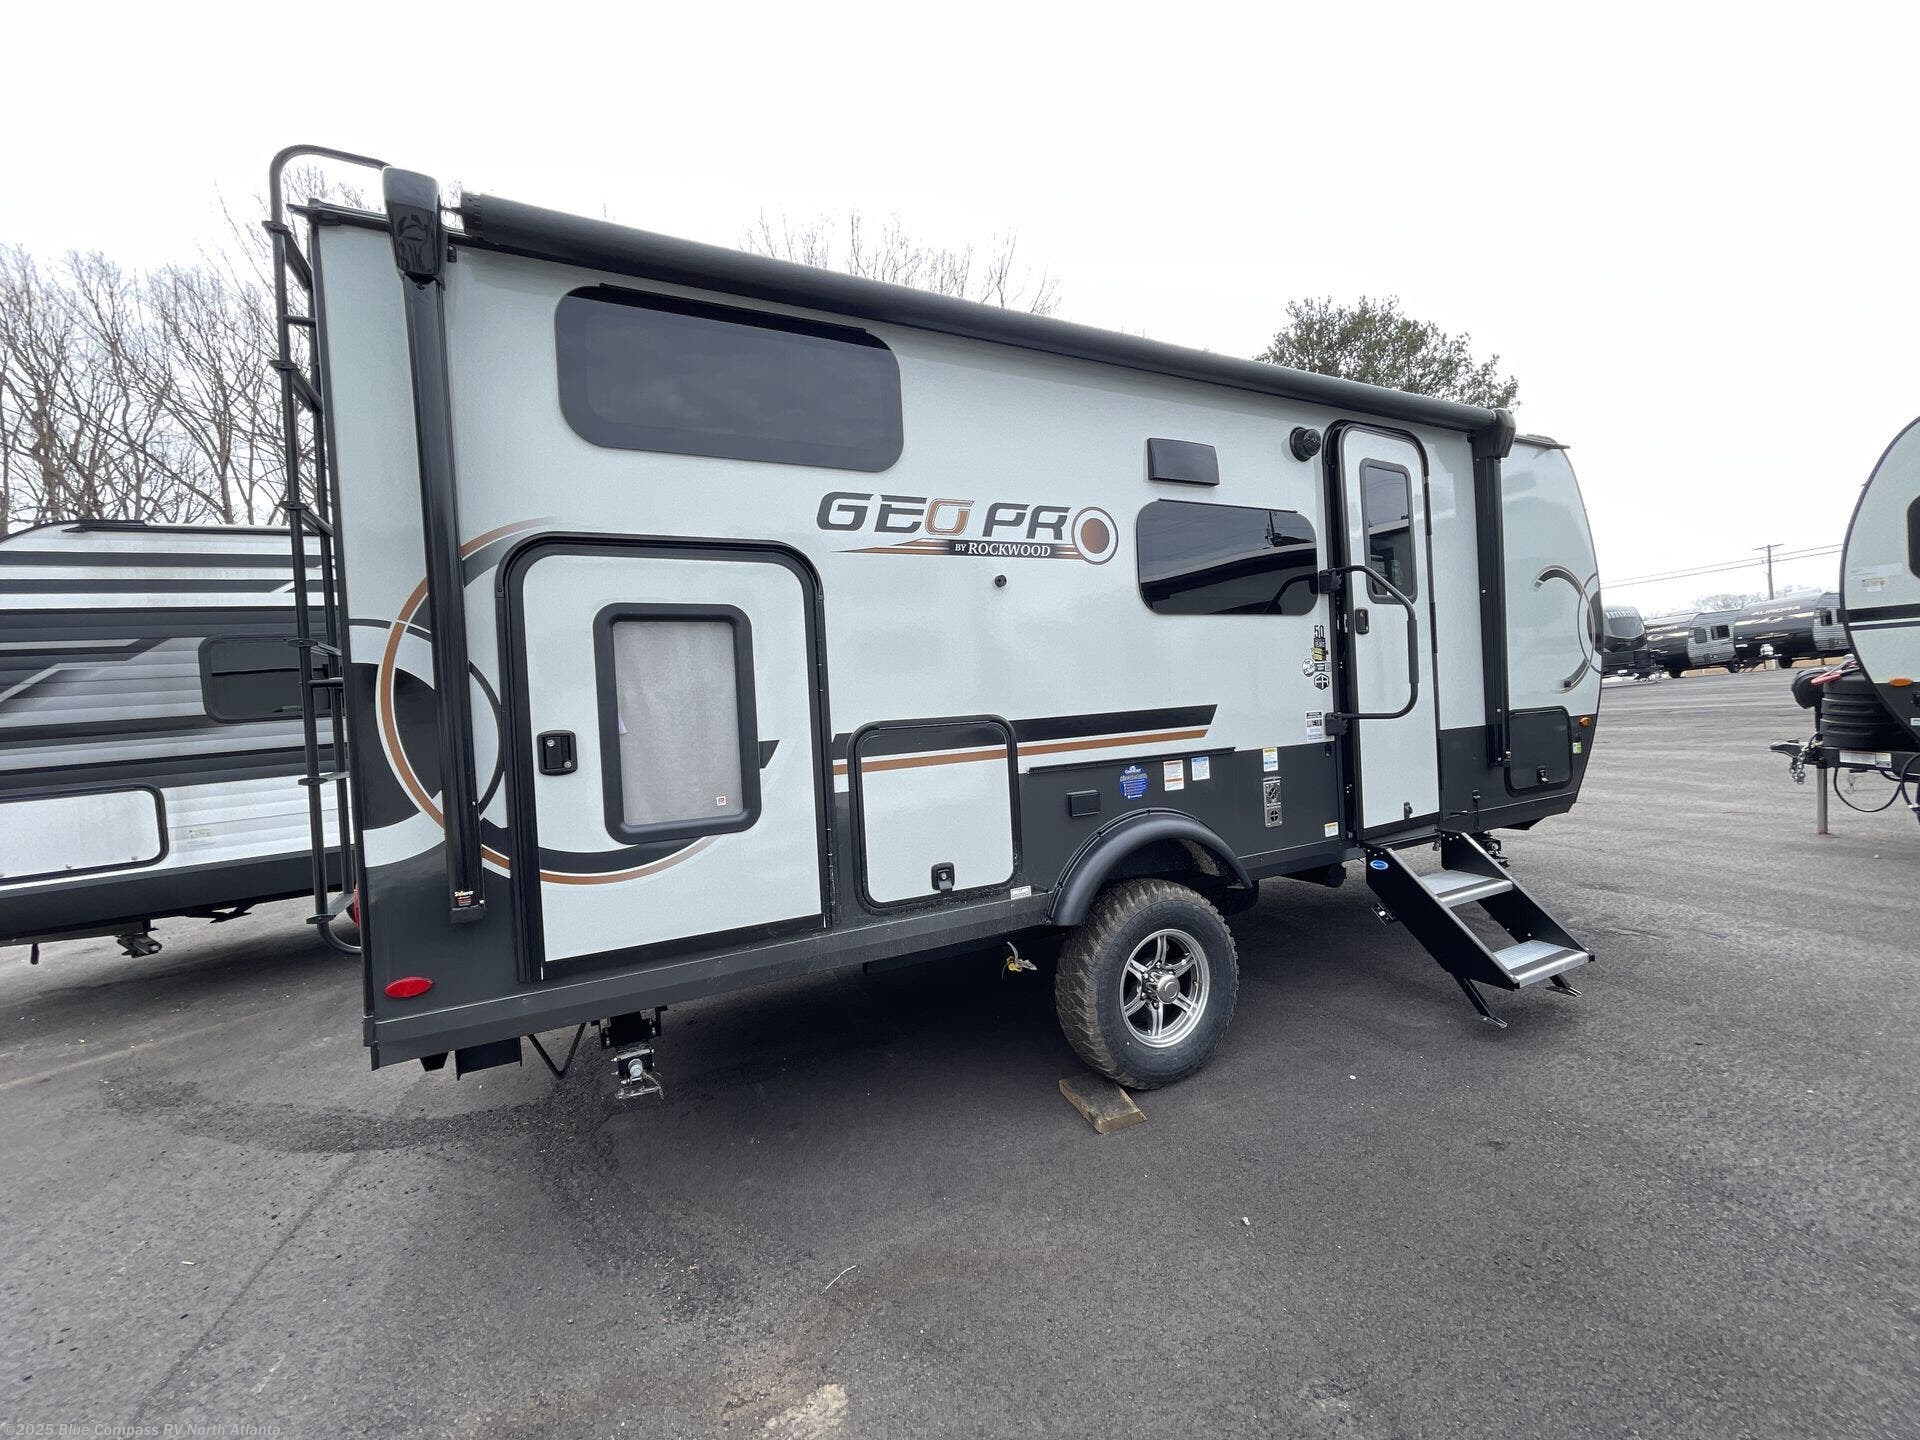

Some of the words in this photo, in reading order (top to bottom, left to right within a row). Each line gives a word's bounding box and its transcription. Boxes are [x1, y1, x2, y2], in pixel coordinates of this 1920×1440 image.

[816, 491, 975, 536] GEO
[954, 543, 967, 551] BY
[967, 542, 1051, 557] ROCKWOOD
